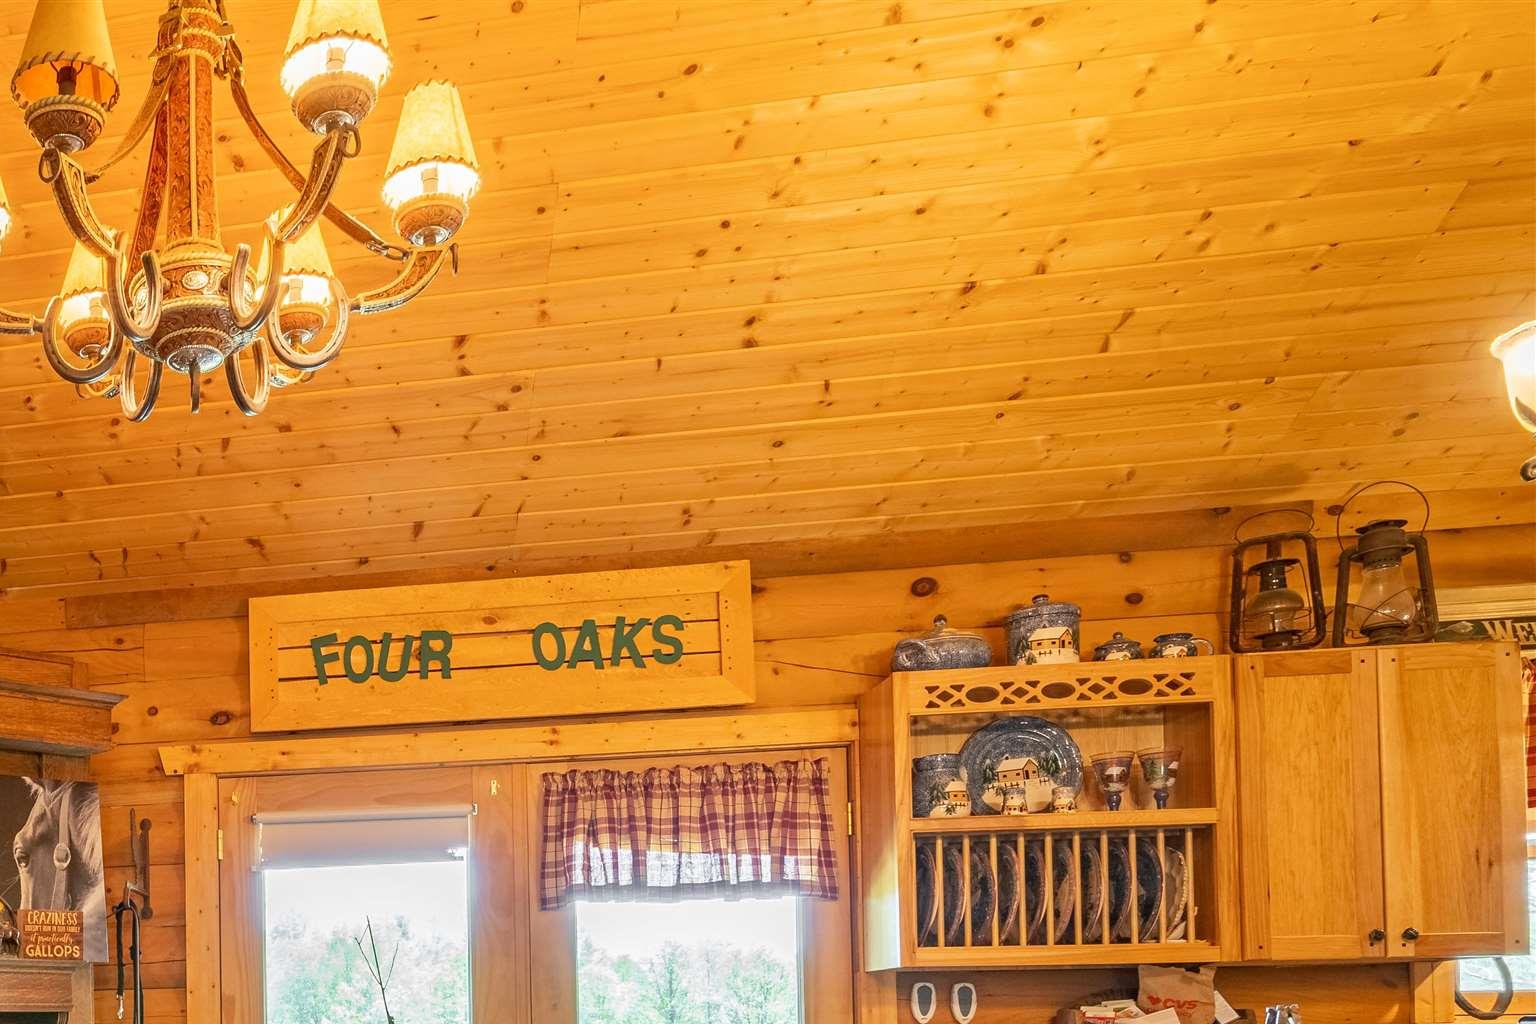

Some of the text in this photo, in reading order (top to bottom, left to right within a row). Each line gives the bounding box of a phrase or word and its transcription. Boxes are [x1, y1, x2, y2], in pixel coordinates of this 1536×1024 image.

[311, 615, 685, 685] FOUR OAKS
[27, 911, 78, 925] CRAZINESS
[25, 944, 80, 958] GALLOPS
[1163, 998, 1198, 1010] CVS
